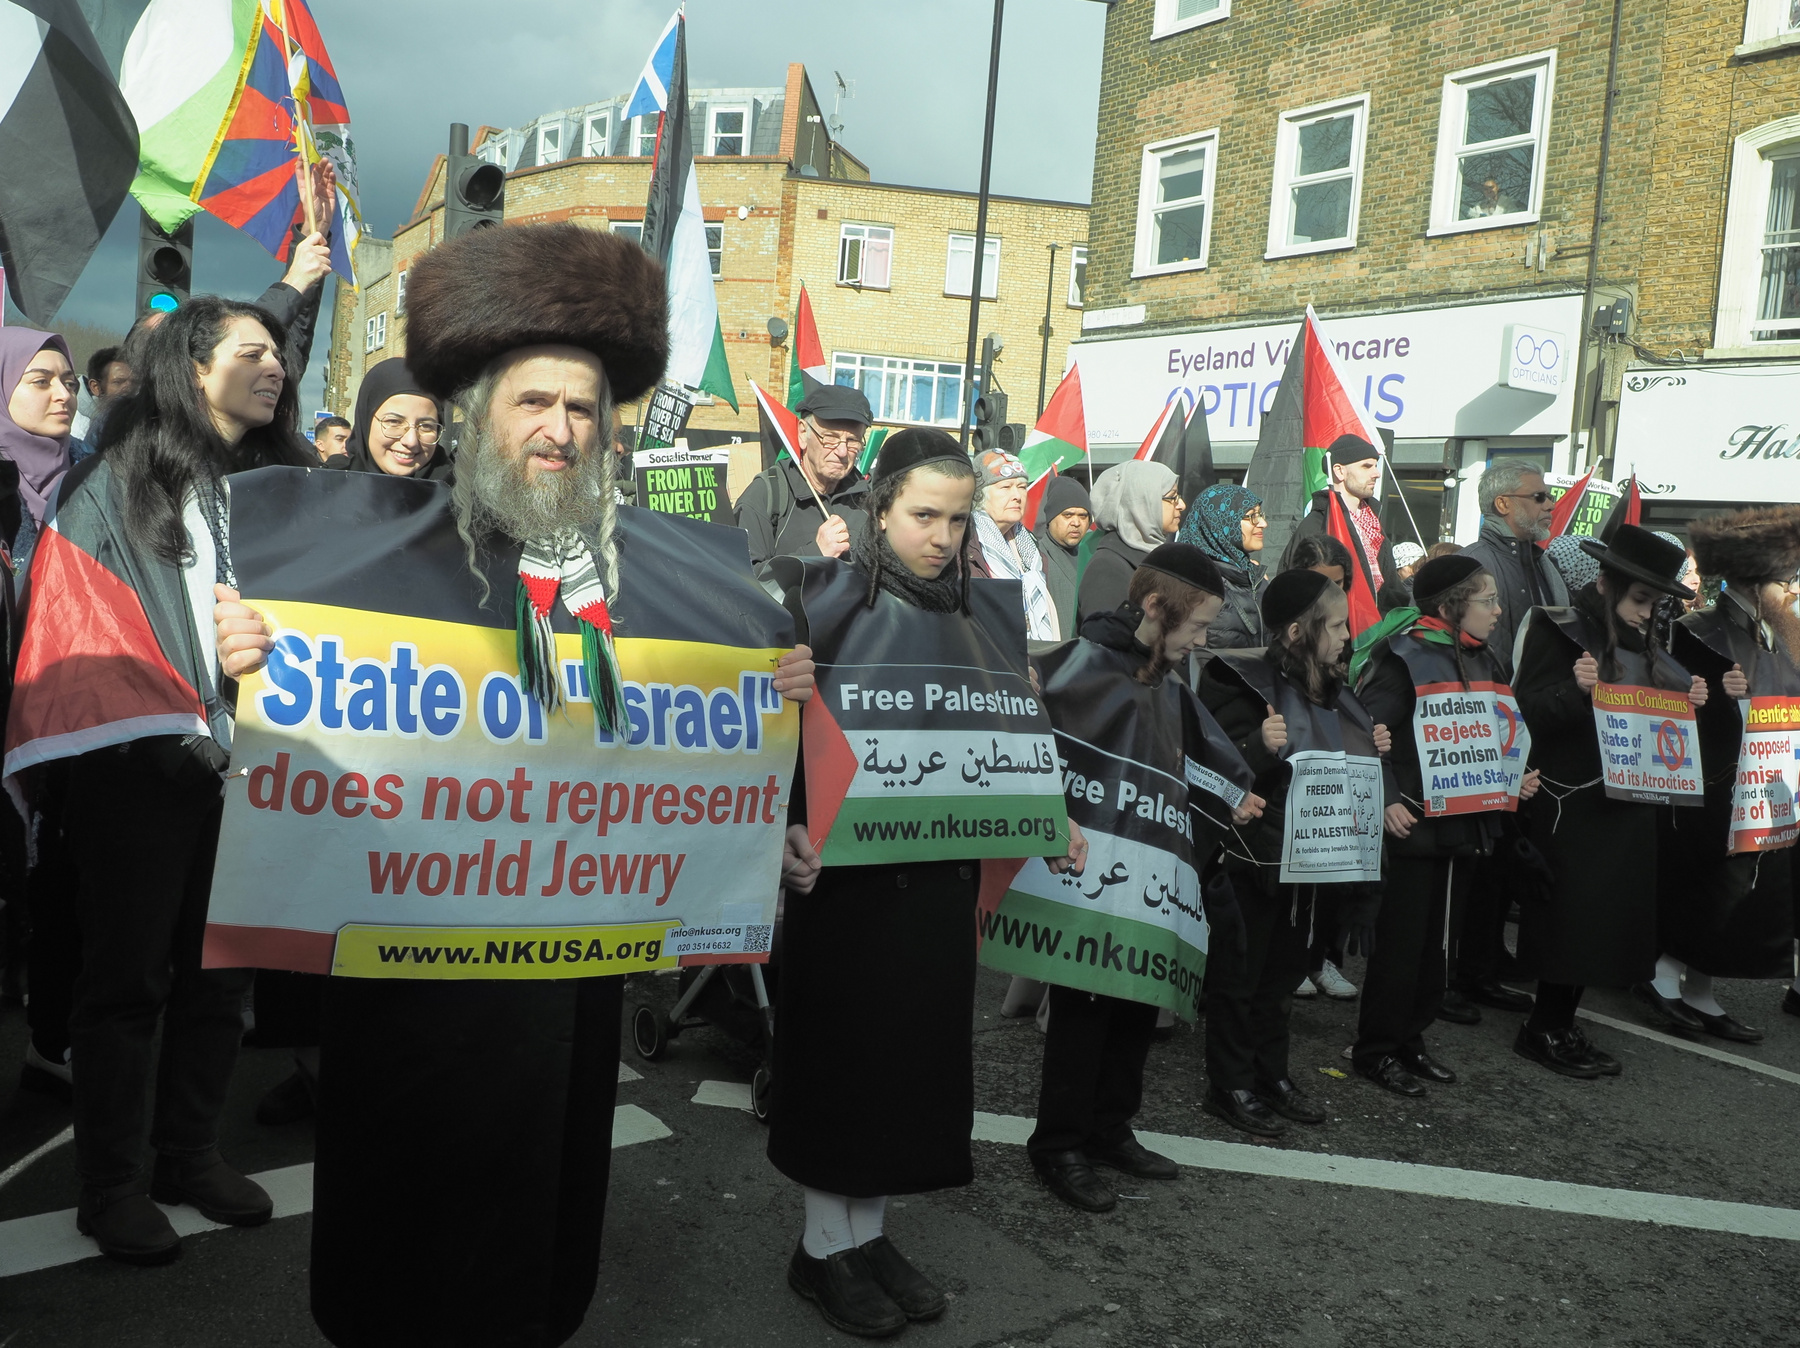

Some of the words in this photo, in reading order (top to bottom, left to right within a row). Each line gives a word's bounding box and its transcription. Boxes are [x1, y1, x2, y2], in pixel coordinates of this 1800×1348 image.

[1168, 343, 1255, 378] Eyeland
[1264, 336, 1411, 366] Vincare
[1512, 367, 1558, 386] OPTICIANS
[653, 391, 676, 413] FROM
[675, 399, 688, 418] THE
[650, 405, 672, 427] RIVER
[671, 414, 681, 430] TO
[647, 420, 661, 438] THE
[660, 427, 675, 444] SEA
[1719, 423, 1800, 460] Hai
[649, 452, 689, 464] Socialist
[646, 467, 692, 492] FROM
[694, 467, 718, 488] THE
[648, 491, 694, 514] RIVER
[697, 489, 717, 511] TO
[1588, 492, 1611, 509] THE
[1586, 508, 1602, 523] TO
[261, 635, 461, 736] State
[840, 684, 914, 711] Free
[925, 683, 1039, 716] Palestine
[1420, 697, 1487, 719] Judaism
[1636, 690, 1689, 714] Condemns
[1606, 715, 1628, 730] the
[1746, 704, 1789, 724] hentic
[1423, 720, 1492, 745] Rejects
[1601, 730, 1629, 747] State
[1632, 734, 1642, 749] of
[1427, 745, 1499, 768] Zionism
[1749, 736, 1790, 760] opposed
[863, 738, 947, 788] عربية
[961, 738, 1055, 788] فلسطين
[1298, 766, 1323, 776] Judaism
[1431, 773, 1459, 791] And
[1462, 771, 1482, 787] the
[1607, 767, 1625, 785] And
[1627, 768, 1640, 787] its
[1642, 771, 1696, 791] Atrocities
[1738, 764, 1783, 786] ionism
[247, 752, 404, 819] does
[421, 767, 533, 823] not
[546, 775, 780, 836] represent
[1306, 784, 1344, 796] FREEDOM
[1740, 788, 1757, 800] and
[1760, 787, 1774, 799] the
[1300, 808, 1311, 818] for
[1312, 805, 1336, 817] GAZA
[1338, 805, 1352, 816] and
[1750, 800, 1765, 820] of
[1769, 798, 1793, 819] Israel
[853, 813, 1056, 842] www.nkusa.org
[1294, 828, 1310, 840] ALL
[1312, 826, 1359, 839] PALESTINE
[1302, 845, 1320, 854] forbids
[1320, 846, 1330, 854] any
[1331, 844, 1348, 852] Jewish
[368, 839, 532, 897] world
[541, 840, 686, 906] Jewry
[671, 927, 741, 938] info@nkusa.org
[378, 939, 662, 962] www.NKUSA.org
[677, 944, 691, 952] 020
[692, 942, 710, 950] 3514
[712, 941, 731, 949] 6632
